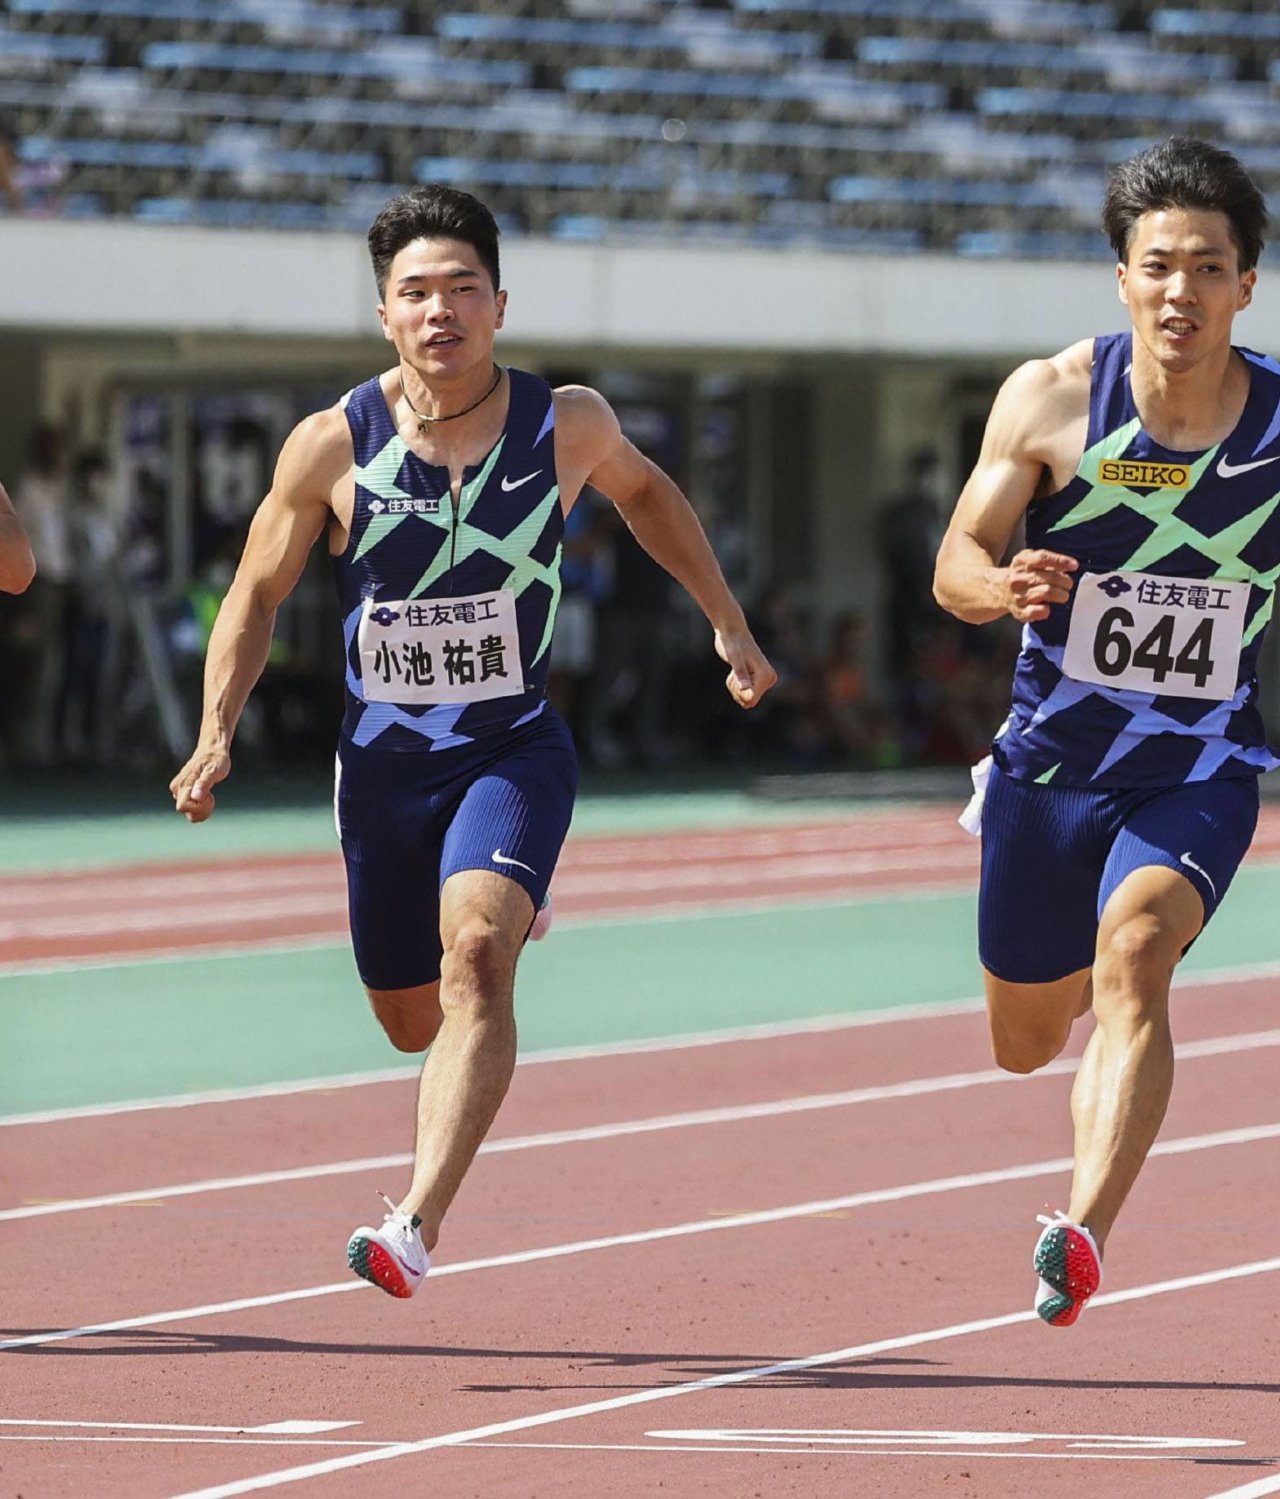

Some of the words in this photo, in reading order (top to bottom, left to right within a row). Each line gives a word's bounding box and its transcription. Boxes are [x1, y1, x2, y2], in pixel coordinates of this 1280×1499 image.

[1102, 463, 1187, 486] SEIKO
[387, 499, 439, 513] 住友電工
[1136, 578, 1232, 610] 住友電工
[405, 598, 499, 627] 住友電工
[373, 640, 435, 686] 小池
[442, 634, 509, 686] 祐貴
[1092, 606, 1215, 688] 644
